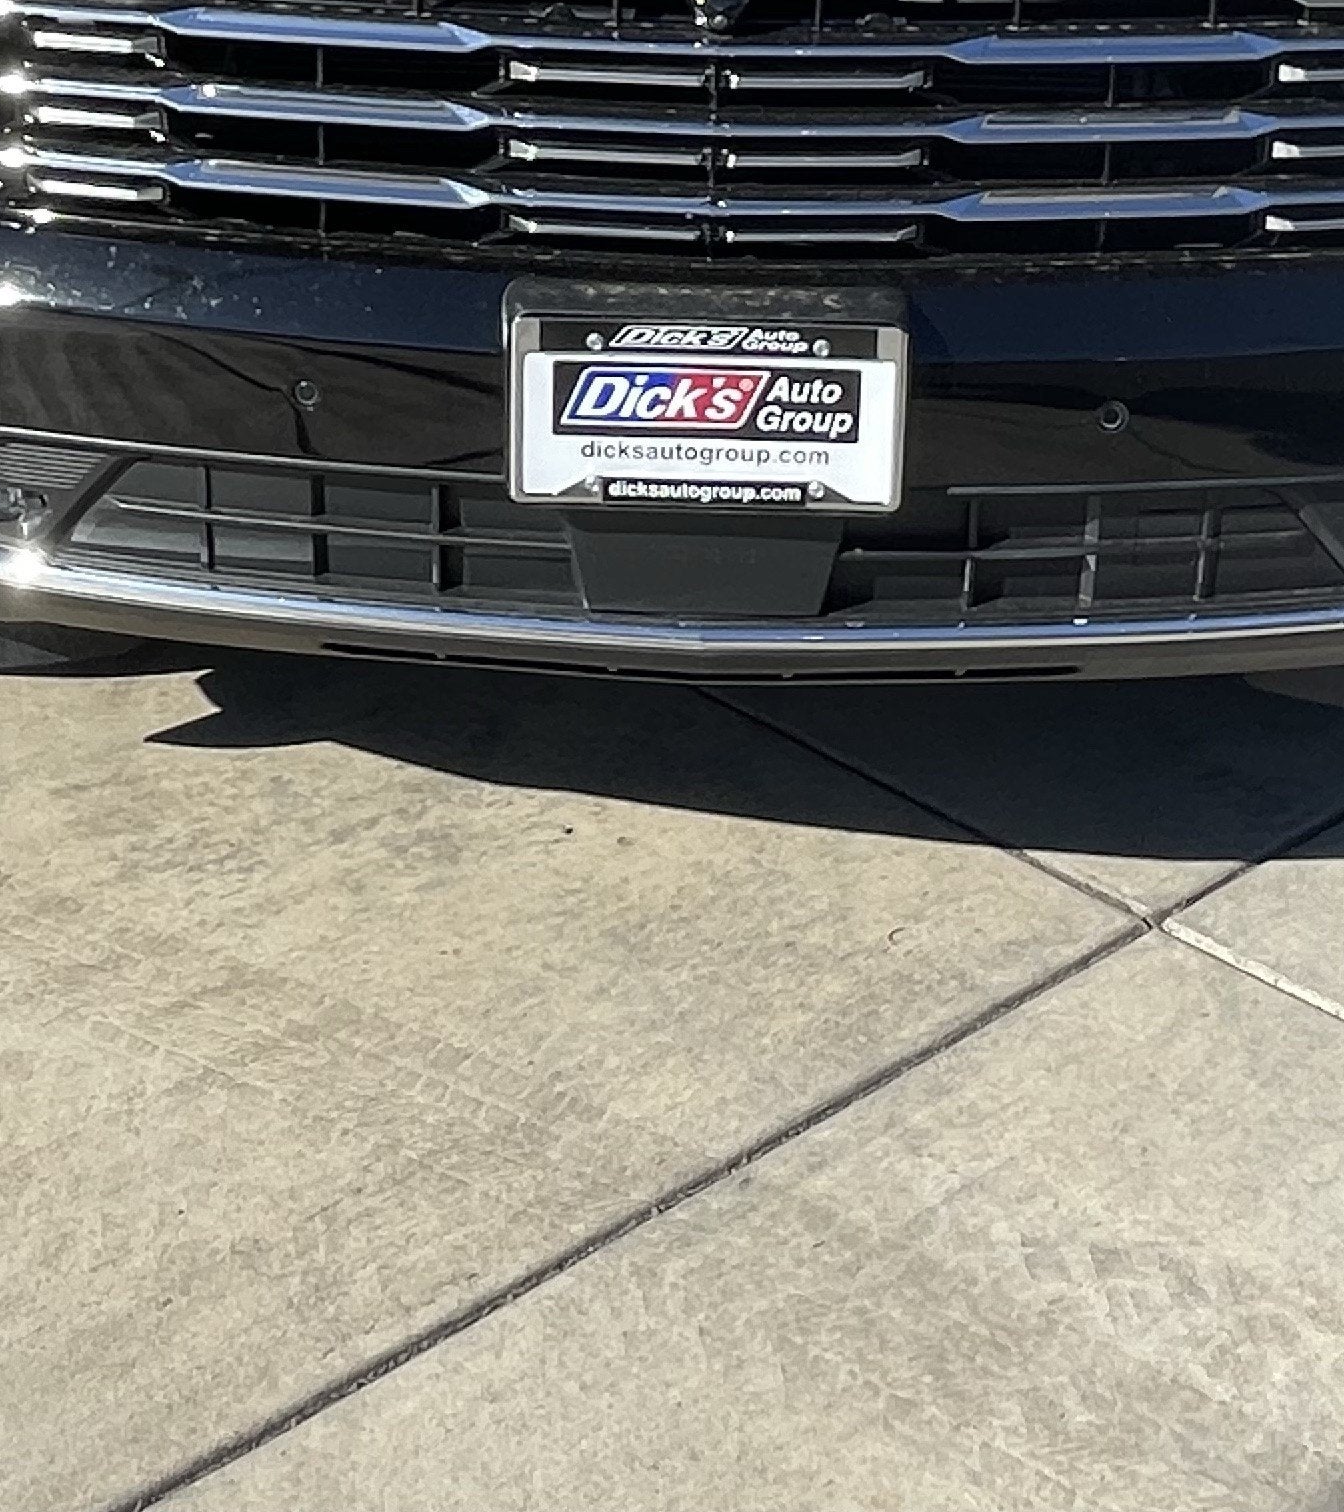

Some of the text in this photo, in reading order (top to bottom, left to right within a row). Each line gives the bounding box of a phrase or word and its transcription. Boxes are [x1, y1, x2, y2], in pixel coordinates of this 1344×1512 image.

[741, 338, 810, 354] Group
[749, 327, 801, 342] Auto
[574, 374, 744, 422] Dick's
[765, 376, 843, 405] Auto
[756, 405, 855, 440] Group
[580, 440, 830, 466] dicksautogroup.com
[607, 480, 803, 503] dicksautogroup.com
